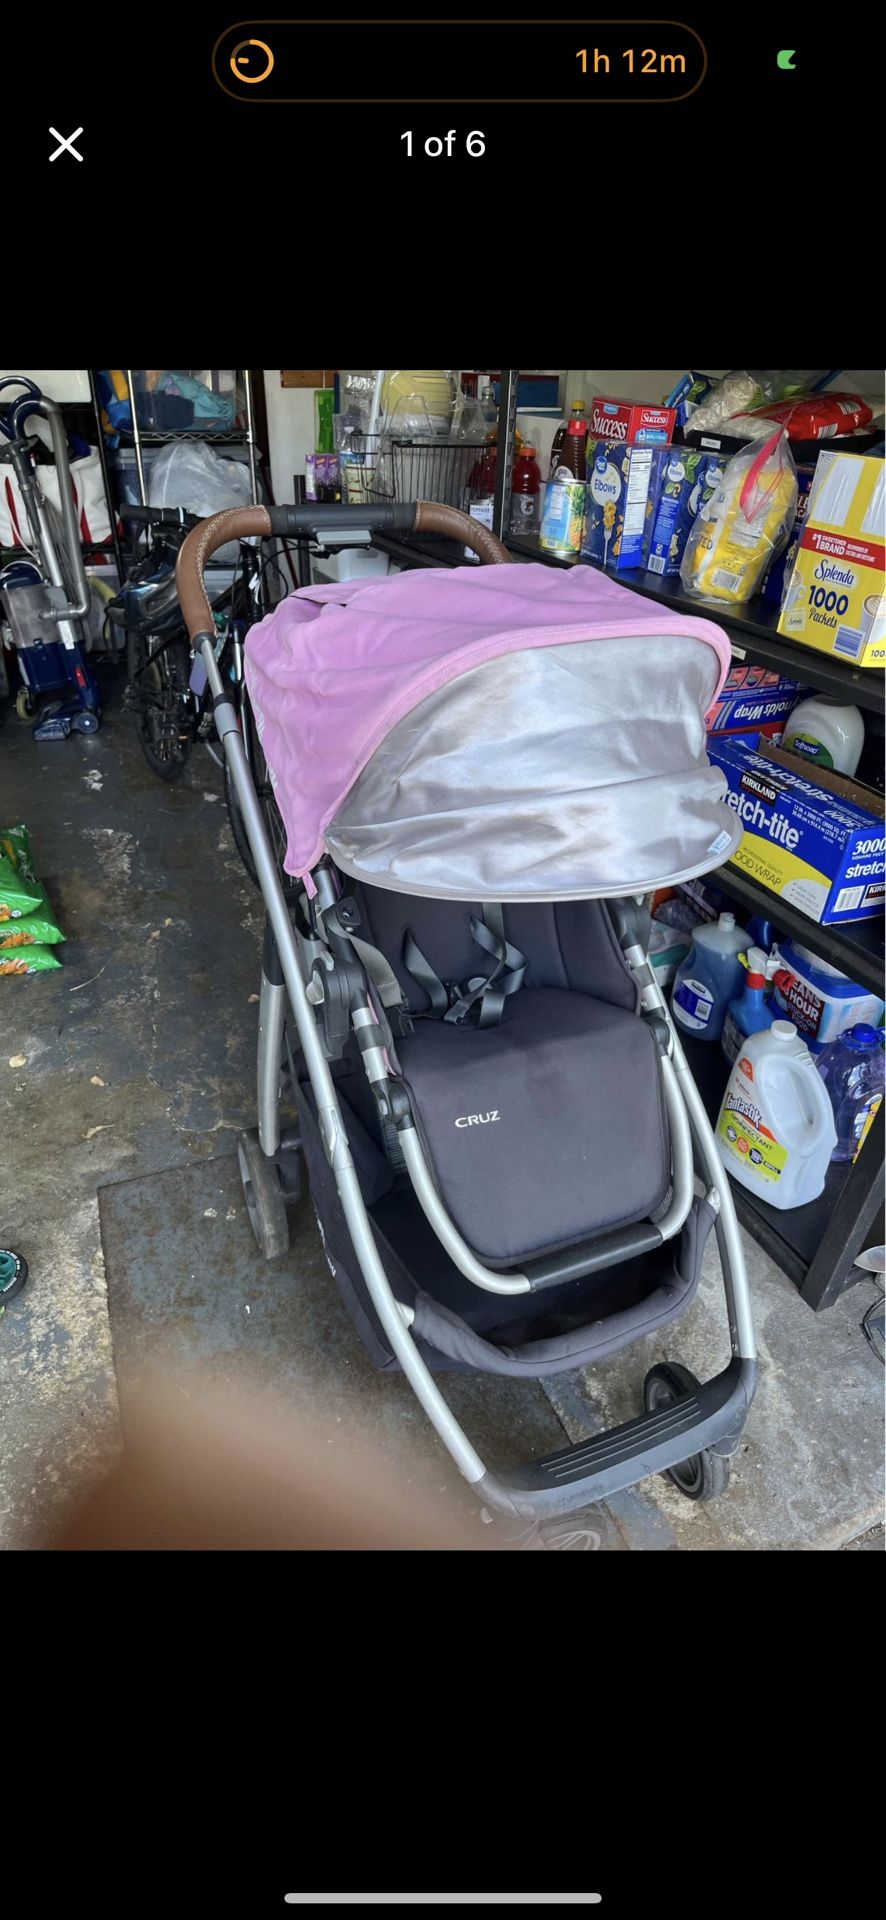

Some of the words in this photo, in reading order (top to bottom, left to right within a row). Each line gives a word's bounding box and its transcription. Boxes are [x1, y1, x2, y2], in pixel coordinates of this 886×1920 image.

[591, 409, 628, 440] Success
[642, 413, 668, 424] Success
[820, 541, 845, 555] BRAND
[814, 559, 854, 585] Splenda
[808, 585, 849, 615] 1000
[808, 608, 837, 628] Packets
[741, 775, 776, 800] KIRKLAND
[755, 864, 781, 886] WRAP
[789, 989, 819, 1021] HOUR
[454, 1110, 501, 1128] CRUZ
